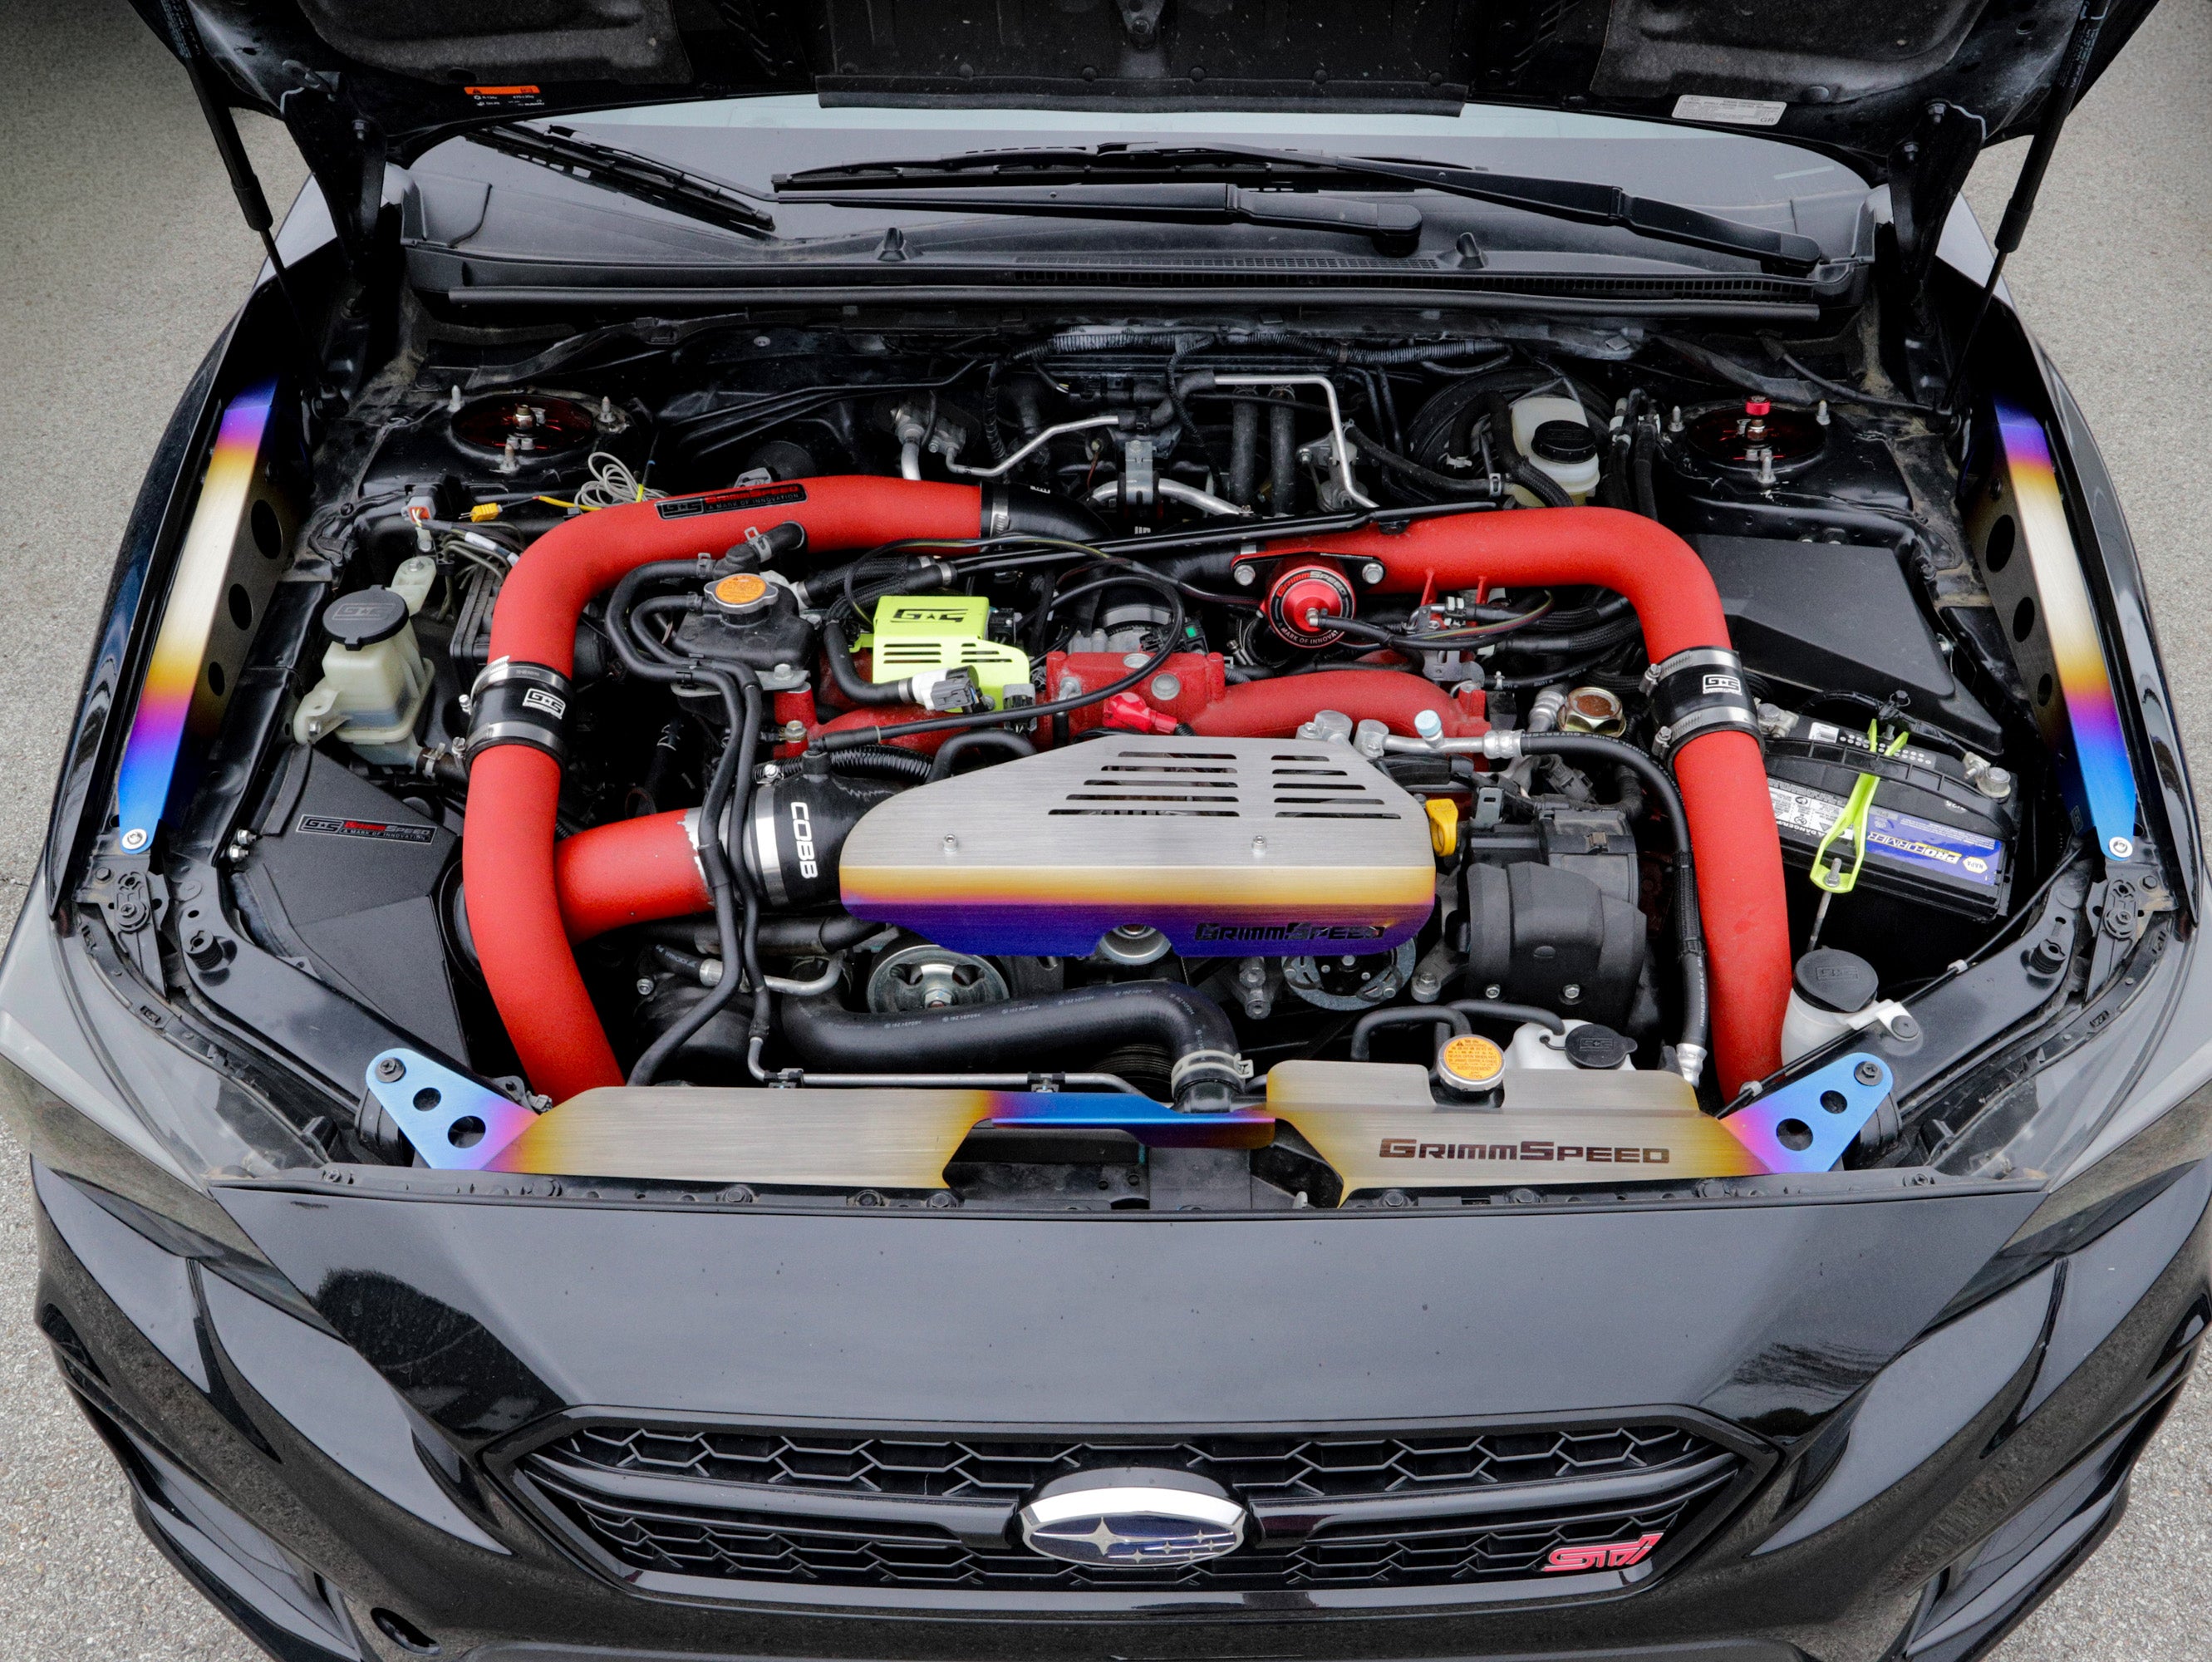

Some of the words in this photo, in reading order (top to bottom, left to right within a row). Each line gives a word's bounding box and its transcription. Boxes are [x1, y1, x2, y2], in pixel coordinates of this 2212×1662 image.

[752, 493, 799, 504] INNOVATION
[1281, 627, 1298, 642] MARK
[790, 802, 818, 878] COBB
[1866, 831, 1961, 864] PROFORMER
[1967, 860, 1983, 869] NAPA
